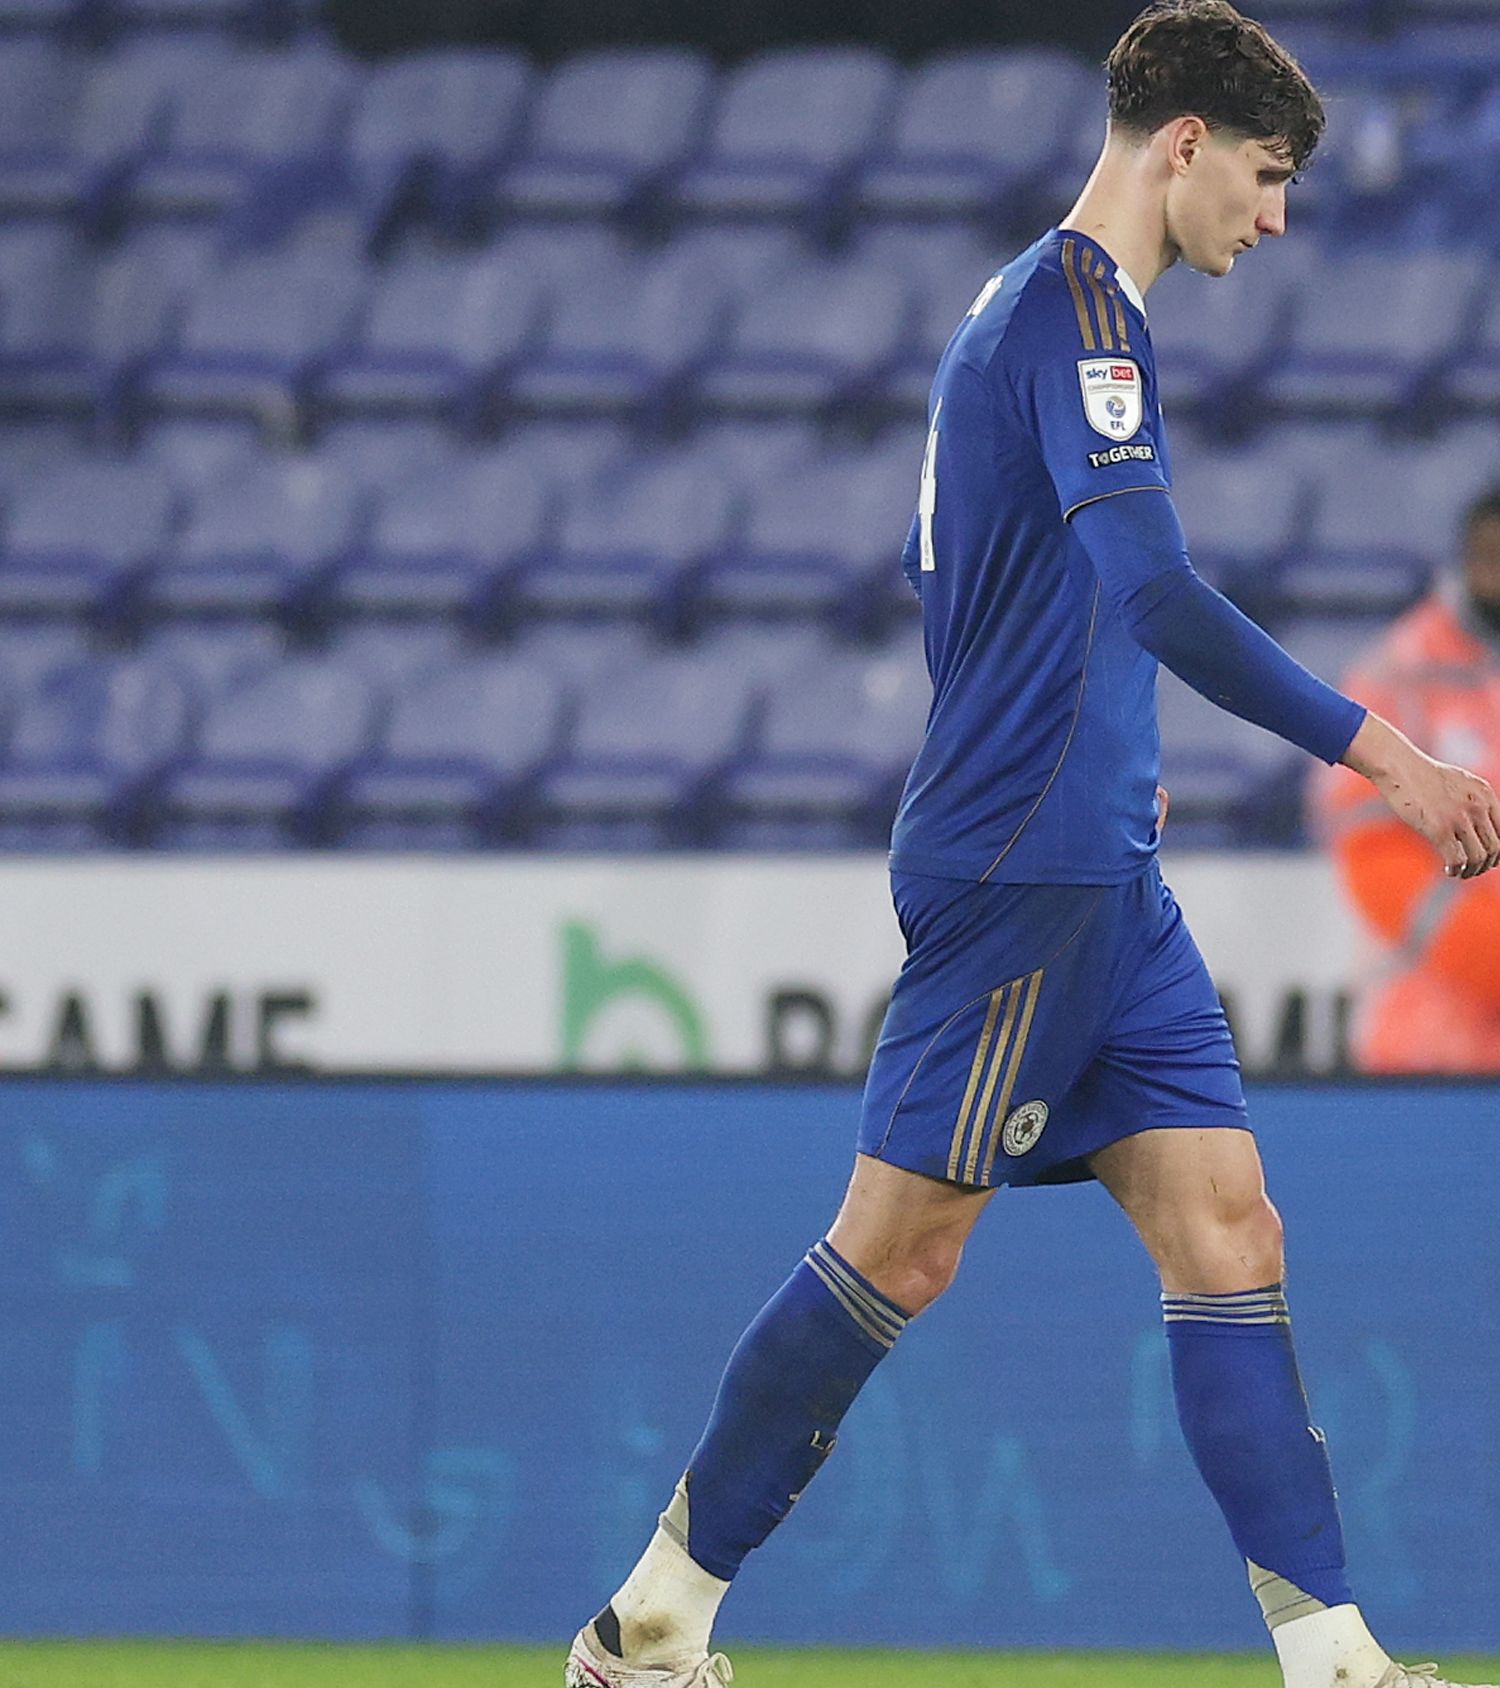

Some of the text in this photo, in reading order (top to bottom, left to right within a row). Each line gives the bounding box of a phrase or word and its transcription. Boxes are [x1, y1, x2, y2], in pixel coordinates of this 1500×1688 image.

[1086, 367, 1133, 380] sky bet
[1110, 421, 1126, 431] EFL
